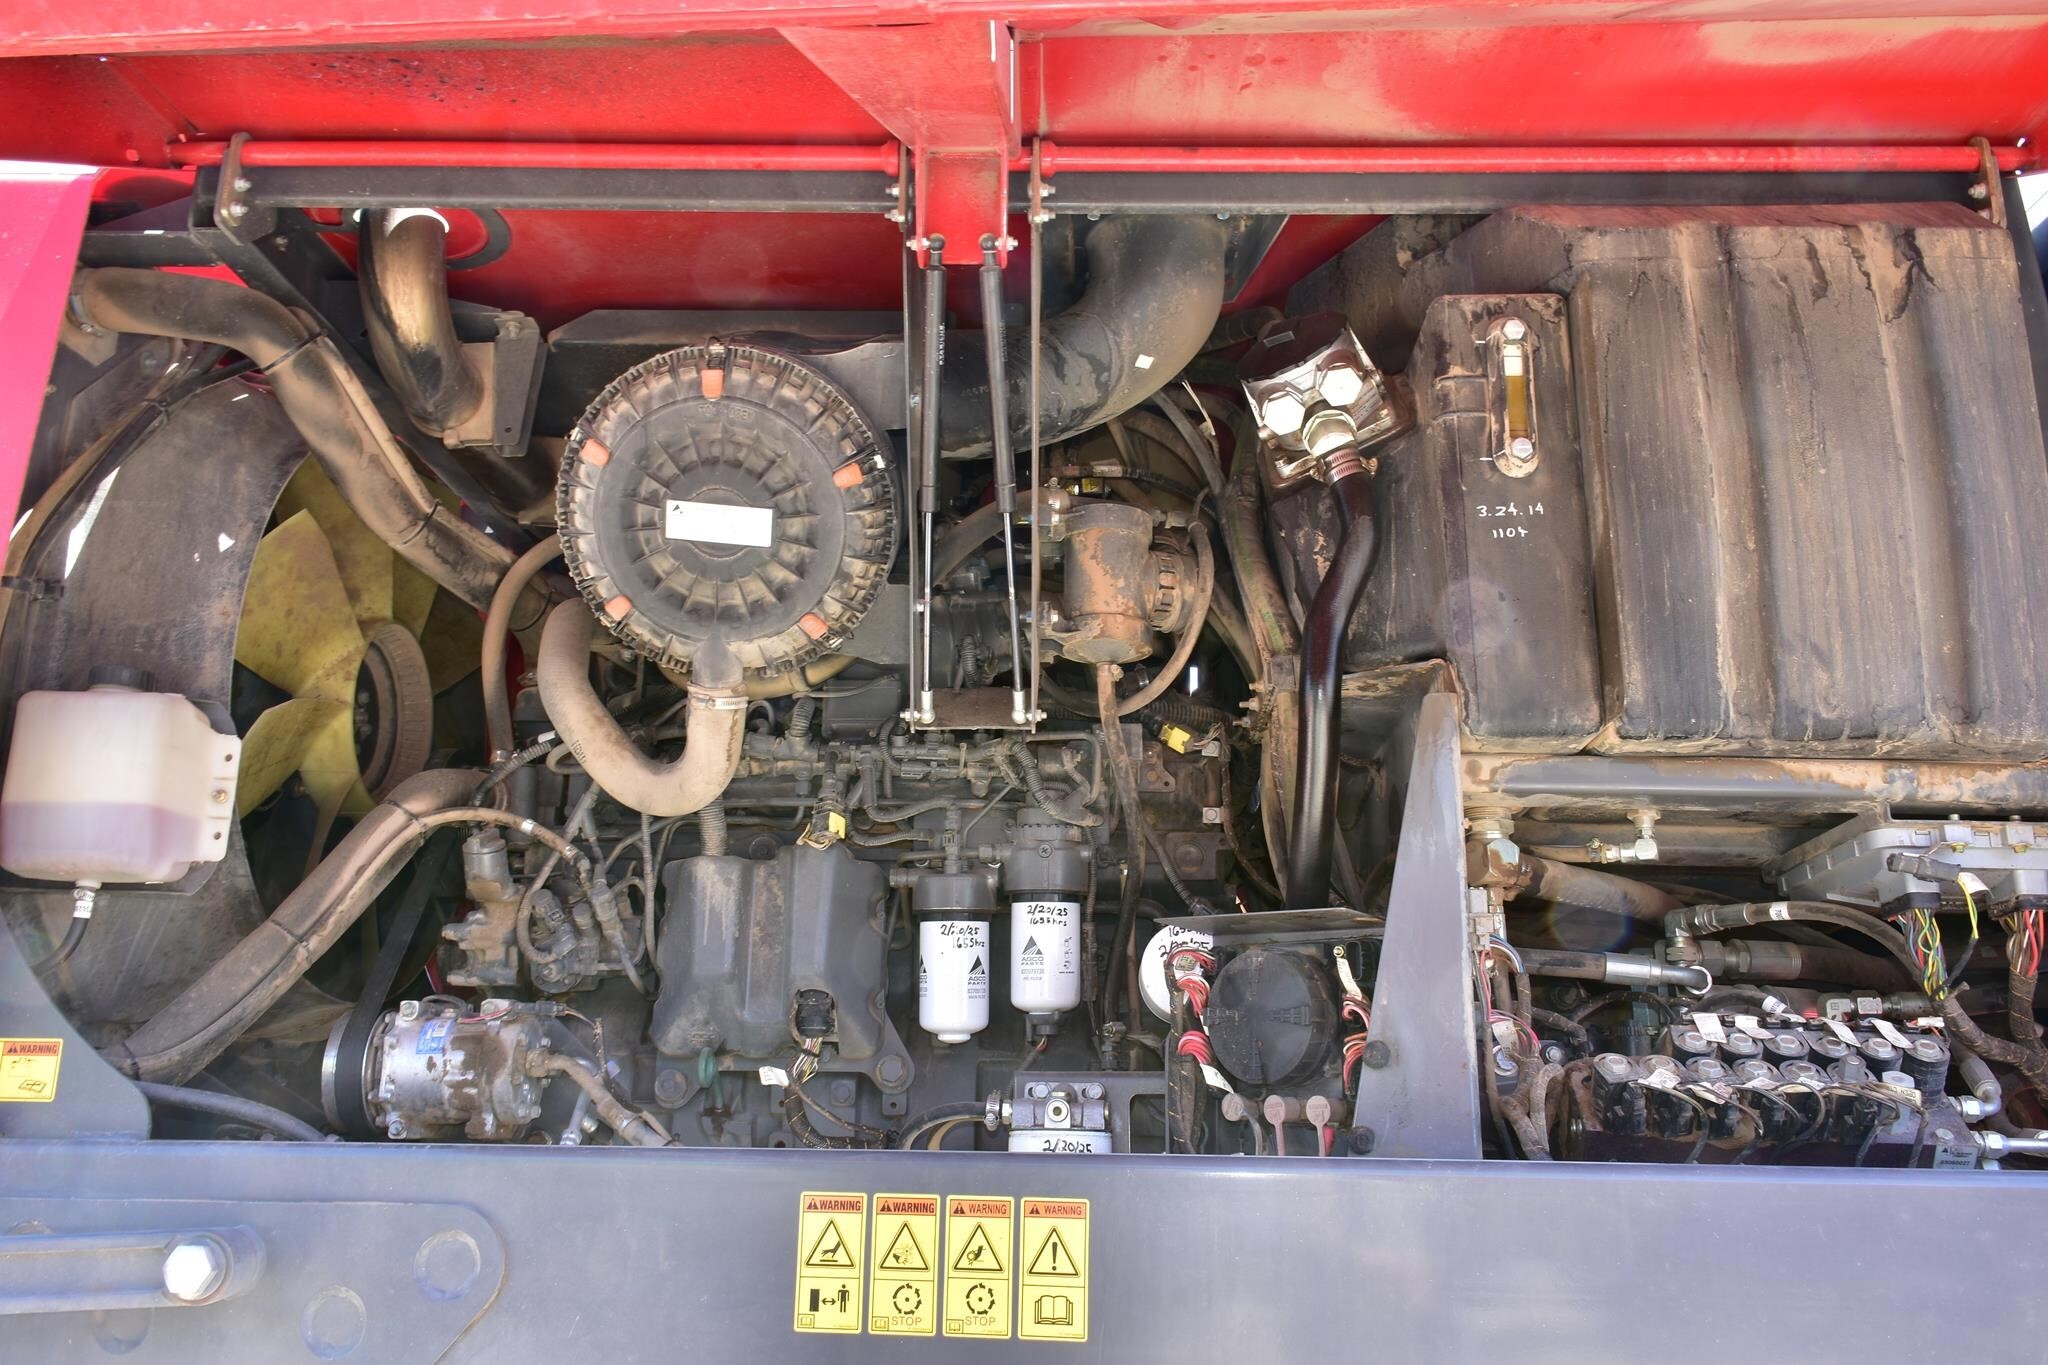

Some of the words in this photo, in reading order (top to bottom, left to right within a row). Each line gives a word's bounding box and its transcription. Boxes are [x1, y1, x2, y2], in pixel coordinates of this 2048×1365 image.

[1476, 502, 1544, 517] 3.24.14
[1492, 526, 1529, 538] 1104
[1027, 904, 1068, 916] 2/20/25
[19, 1044, 57, 1054] WARNING
[819, 1200, 861, 1212] WARNING
[892, 1202, 935, 1213] WARNING
[968, 1203, 1007, 1215] WARNING
[1044, 1205, 1082, 1215] WARNING
[891, 1315, 922, 1326] STOP
[965, 1315, 996, 1326] STOP
